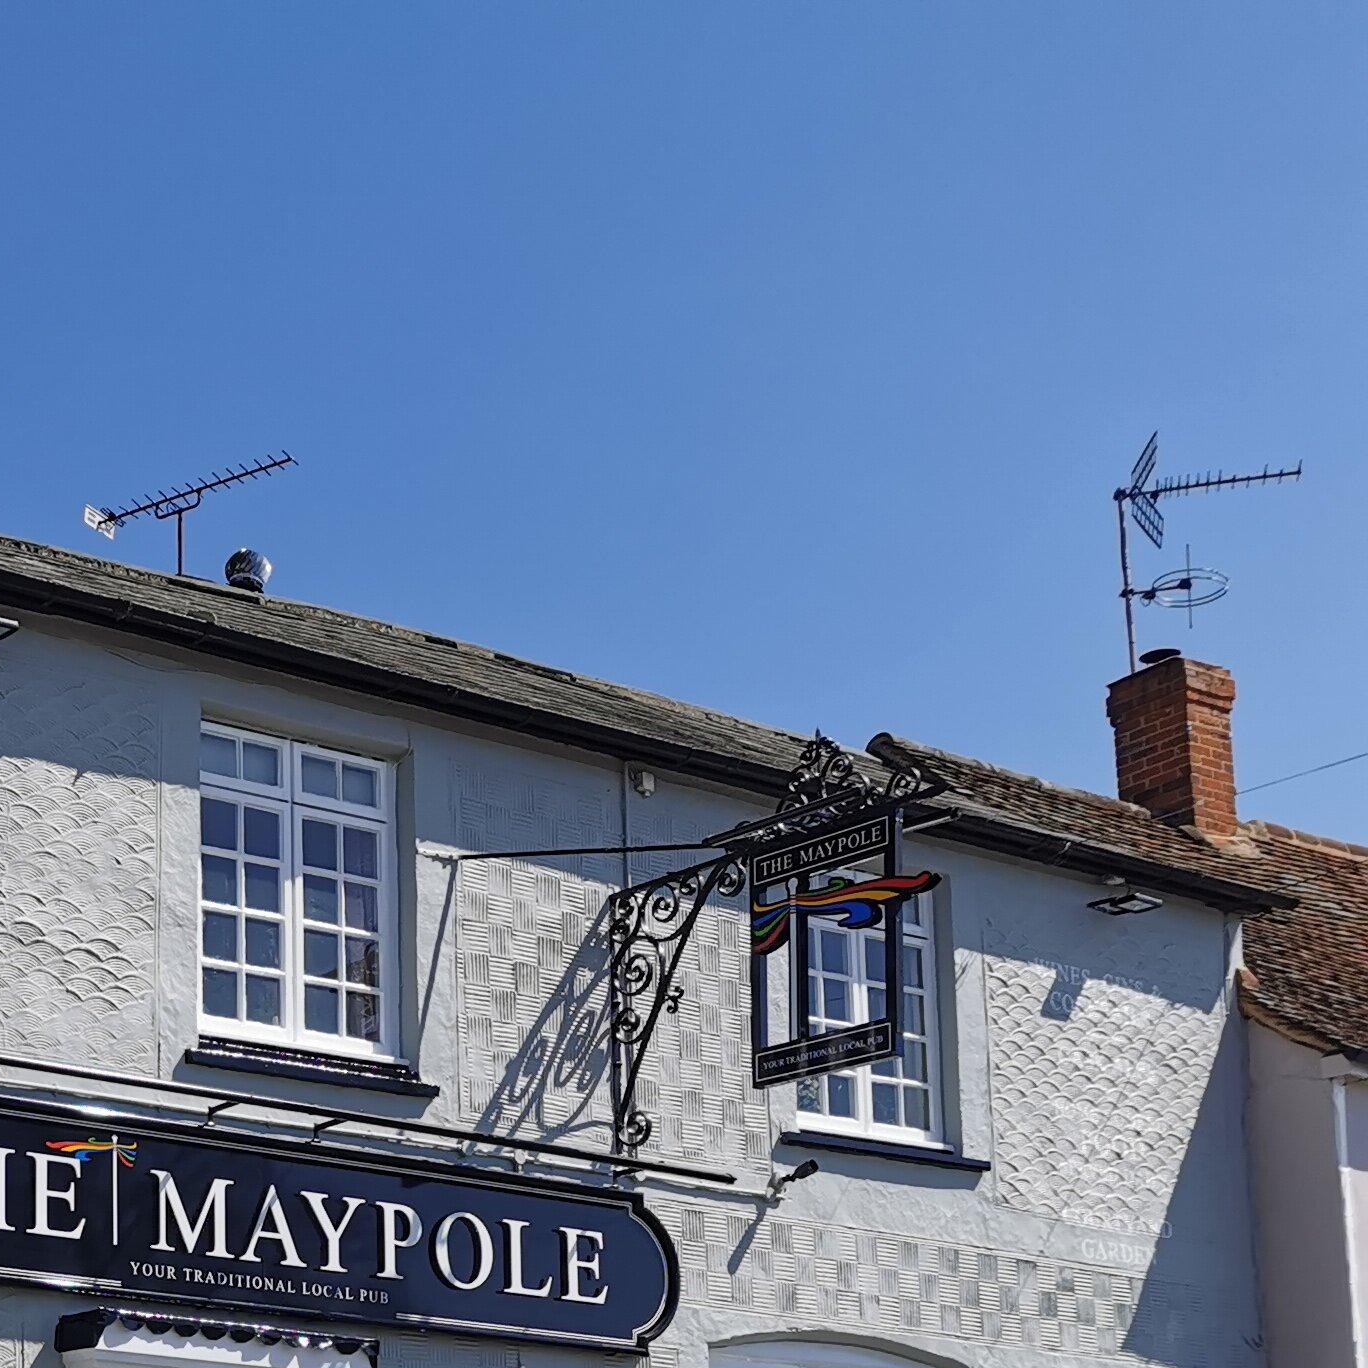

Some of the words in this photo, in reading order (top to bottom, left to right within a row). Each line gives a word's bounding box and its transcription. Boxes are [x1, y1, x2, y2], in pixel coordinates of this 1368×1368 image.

[760, 854, 793, 876] THE
[799, 825, 882, 865] MAYPOLE
[762, 1058, 785, 1070] YOUR
[839, 1040, 866, 1053] LOCAL
[149, 1168, 610, 1305] MAYPOLE
[130, 1261, 177, 1280] YOUR
[183, 1267, 296, 1294] TRADITIONAL
[302, 1281, 354, 1301] LOCAL
[360, 1289, 389, 1304] PUB
